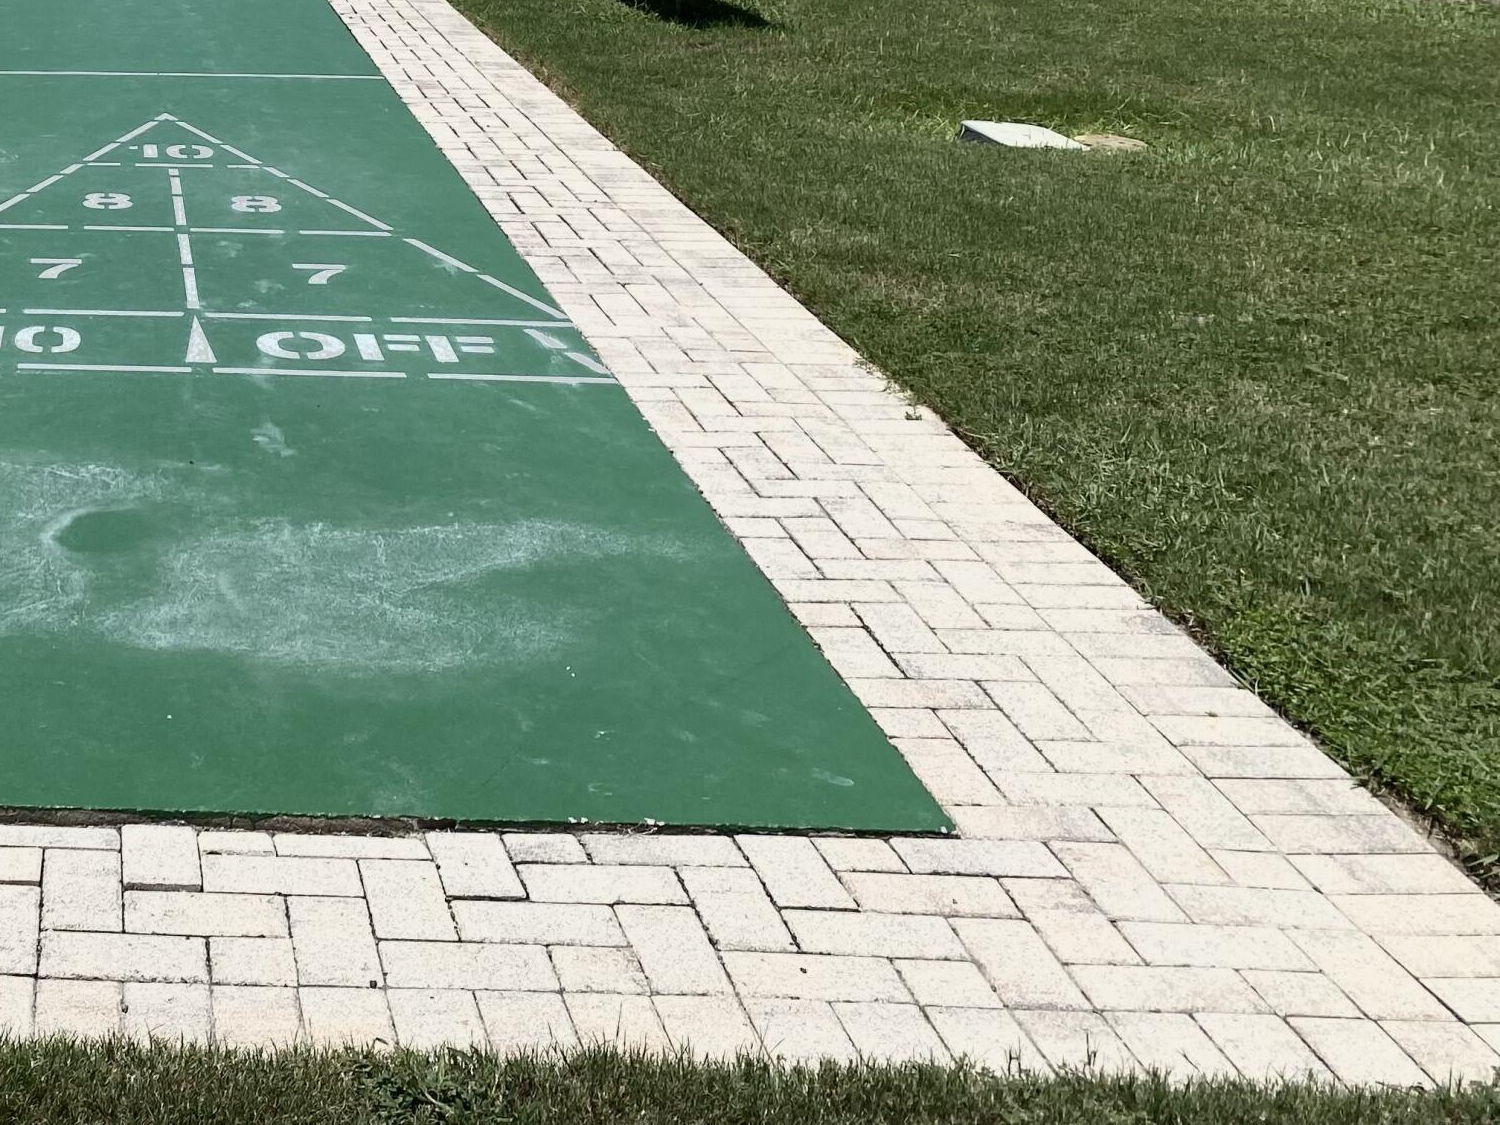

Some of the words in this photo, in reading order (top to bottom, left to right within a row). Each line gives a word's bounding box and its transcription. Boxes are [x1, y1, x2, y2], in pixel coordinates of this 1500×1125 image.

[128, 143, 214, 159] 10
[82, 192, 134, 210] 8
[231, 195, 282, 213] 8
[30, 257, 83, 279] 7
[291, 263, 347, 285] 7
[255, 331, 496, 363] OFF
